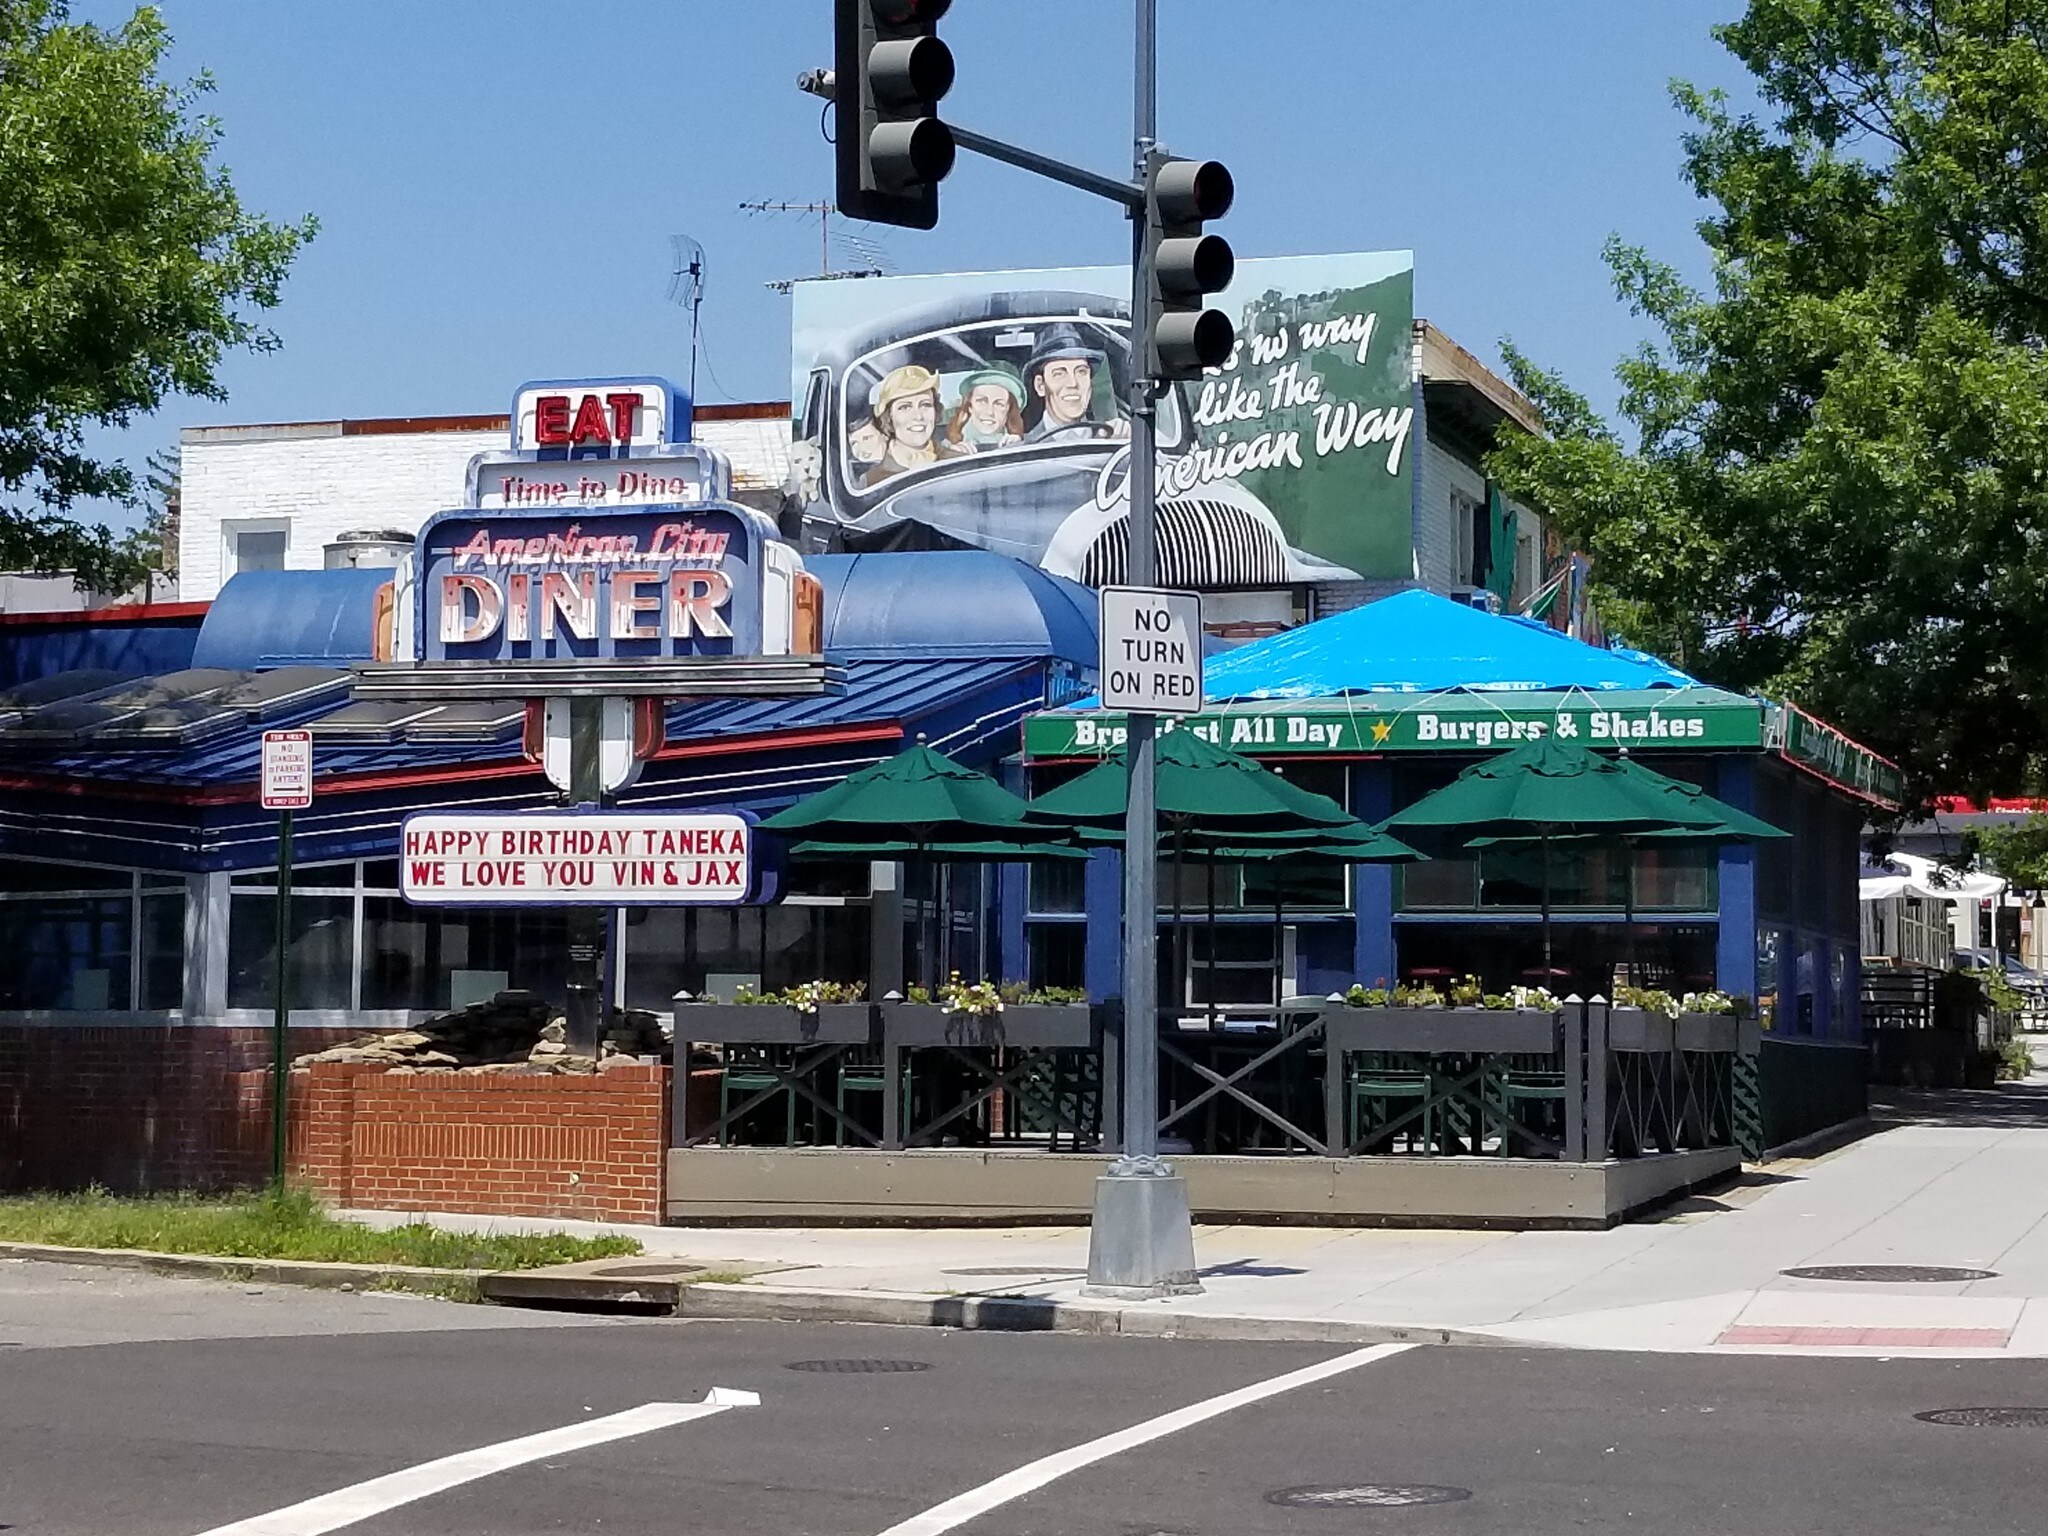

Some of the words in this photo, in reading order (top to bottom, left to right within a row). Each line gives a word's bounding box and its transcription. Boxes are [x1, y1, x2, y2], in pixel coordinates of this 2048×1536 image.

[1298, 313, 1376, 364] way
[1194, 376, 1265, 426] like
[1268, 361, 1321, 412] the
[535, 393, 643, 444] EAT
[1312, 402, 1414, 476] Way
[499, 476, 568, 503] Time
[577, 477, 607, 498] to
[617, 471, 688, 497] Dine
[455, 524, 638, 566] American
[648, 520, 731, 564] City
[439, 570, 734, 642] DINER
[1135, 608, 1171, 633] NO
[1122, 639, 1184, 664] TURN
[1110, 670, 1140, 694] ON
[1153, 673, 1194, 697] RED
[1231, 717, 1275, 743] All
[1287, 717, 1343, 748] Day
[1417, 714, 1542, 745] Burgers
[1556, 714, 1578, 739] &
[1590, 712, 1704, 738] Shakes
[281, 743, 293, 752] NO
[406, 831, 489, 856] HAPPY
[501, 830, 631, 855] BIRTHDAY
[643, 830, 744, 855] TANEKA
[411, 862, 445, 886] WE
[462, 861, 526, 886] LOVE
[543, 861, 594, 886] YOU
[613, 861, 655, 886] VIN
[663, 861, 678, 885] &
[686, 861, 741, 885] JAX
